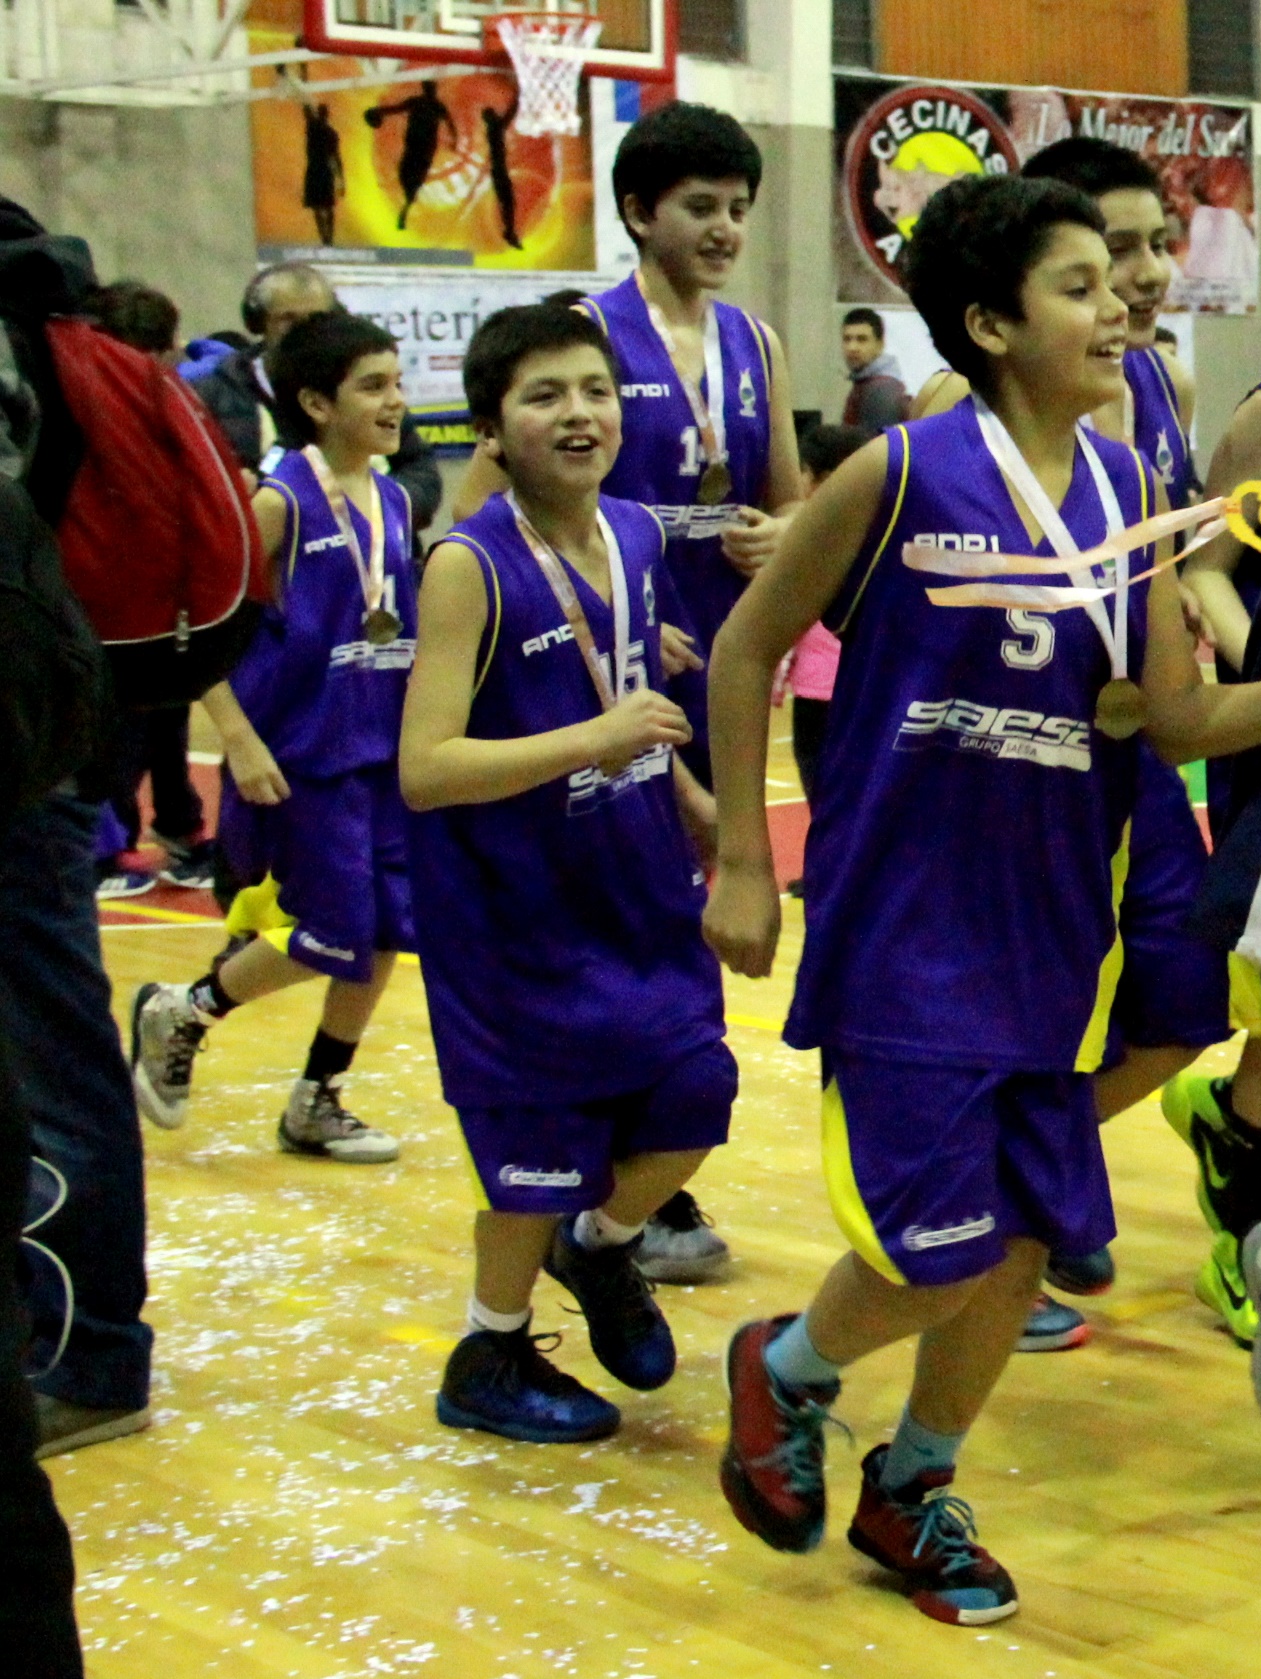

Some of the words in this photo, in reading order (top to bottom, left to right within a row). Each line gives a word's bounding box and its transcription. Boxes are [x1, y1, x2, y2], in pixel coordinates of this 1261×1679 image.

[1157, 112, 1196, 156] del
[1001, 606, 1056, 671] 5
[958, 735, 1000, 754] GRUPO
